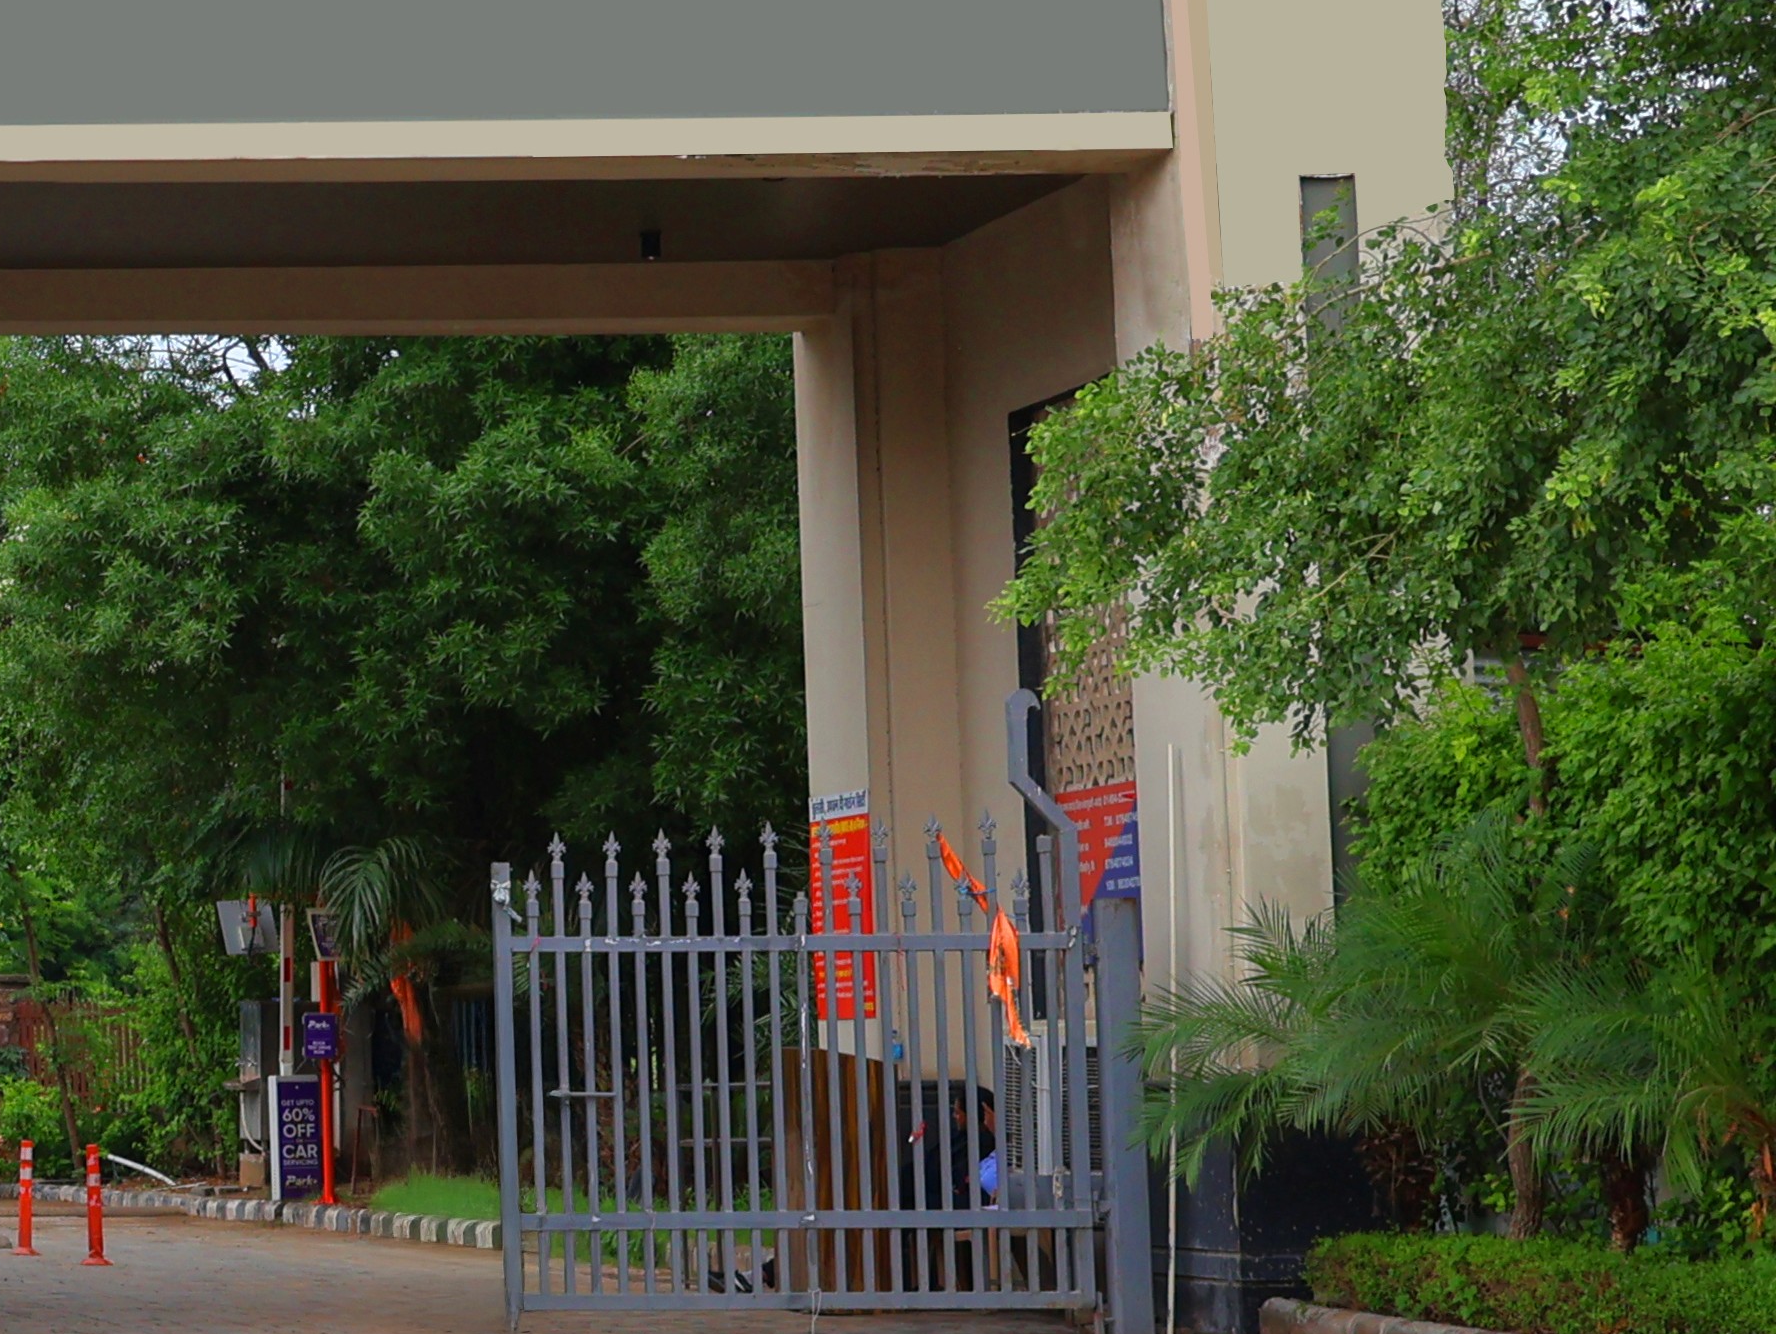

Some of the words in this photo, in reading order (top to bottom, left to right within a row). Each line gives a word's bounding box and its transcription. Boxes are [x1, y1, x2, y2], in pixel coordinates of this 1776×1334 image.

[281, 1099, 294, 1107] GET
[282, 1108, 316, 1122] 60%
[282, 1124, 316, 1138] OFF
[282, 1144, 318, 1158] CAR
